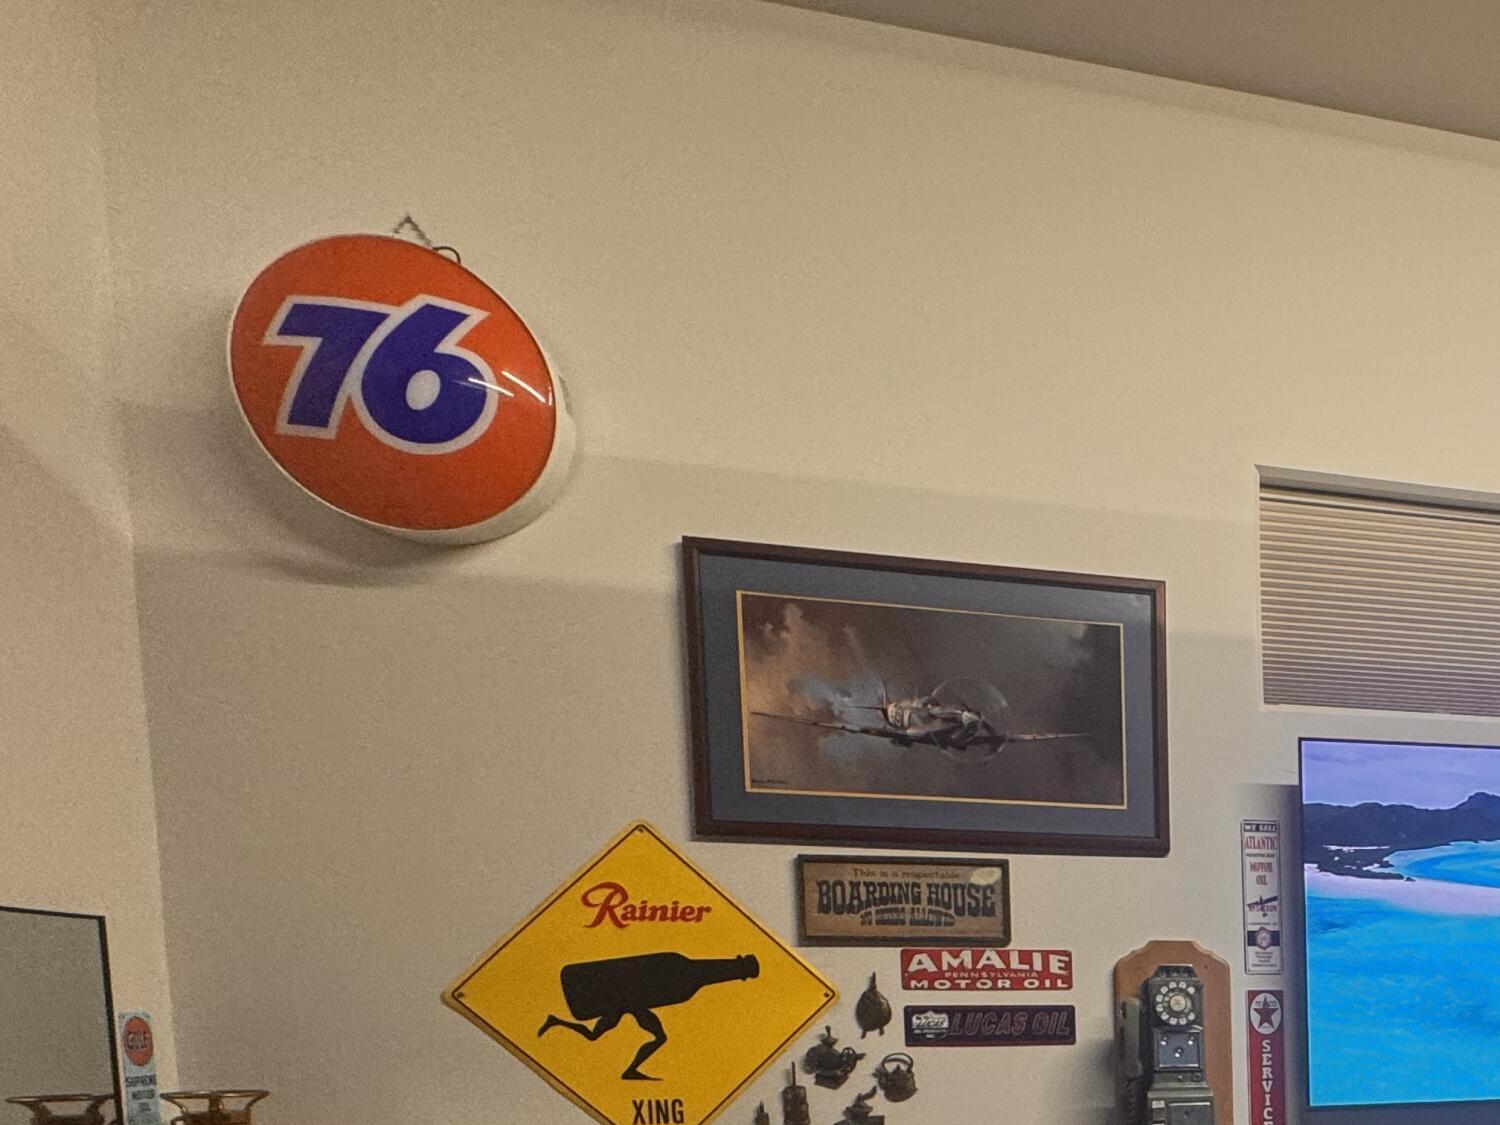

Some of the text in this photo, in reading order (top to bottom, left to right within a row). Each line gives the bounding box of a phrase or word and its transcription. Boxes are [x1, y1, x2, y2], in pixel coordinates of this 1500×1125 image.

[265, 295, 497, 453] 76
[581, 882, 712, 929] Rainier
[816, 879, 921, 915] BOARDING
[927, 881, 996, 917] HOUSE
[907, 950, 1069, 975] AMALIE
[910, 978, 1069, 990] MOTOR OIL
[950, 1012, 1027, 1036] LUCAS
[1032, 1012, 1070, 1036] OIL
[632, 1098, 685, 1125] XING
